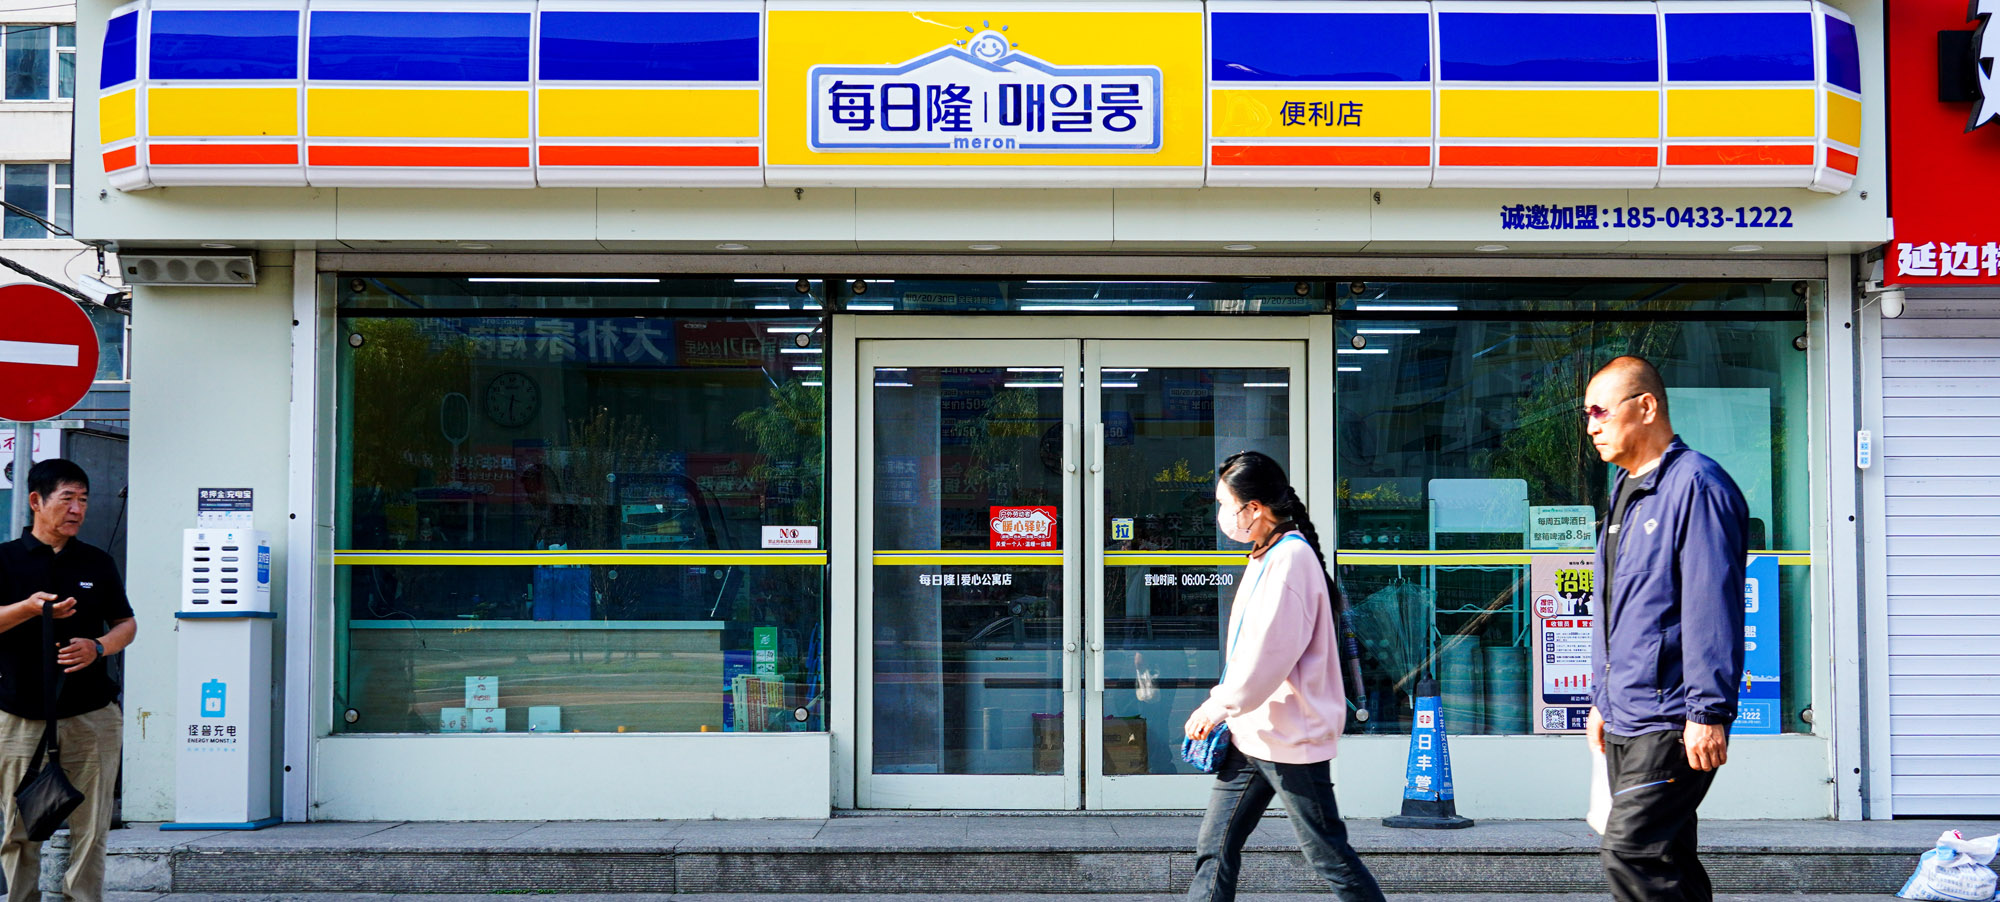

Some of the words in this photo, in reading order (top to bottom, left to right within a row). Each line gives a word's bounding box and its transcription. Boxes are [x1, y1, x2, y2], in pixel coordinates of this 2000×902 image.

[828, 80, 973, 132] 每日隆
[998, 83, 1143, 133] 매일룽
[1280, 100, 1363, 127] 便利店
[954, 135, 1016, 150] meron
[1002, 520, 1047, 532] 暖心驿站
[1538, 516, 1587, 526] 每周五啤酒日
[1115, 524, 1130, 538] 拉
[1534, 530, 1591, 541] 整箱啤酒8.8折
[1181, 574, 1233, 586] 06:00-23:00
[188, 724, 237, 737] 怪兽充电
[1415, 734, 1433, 793] 日丰管
